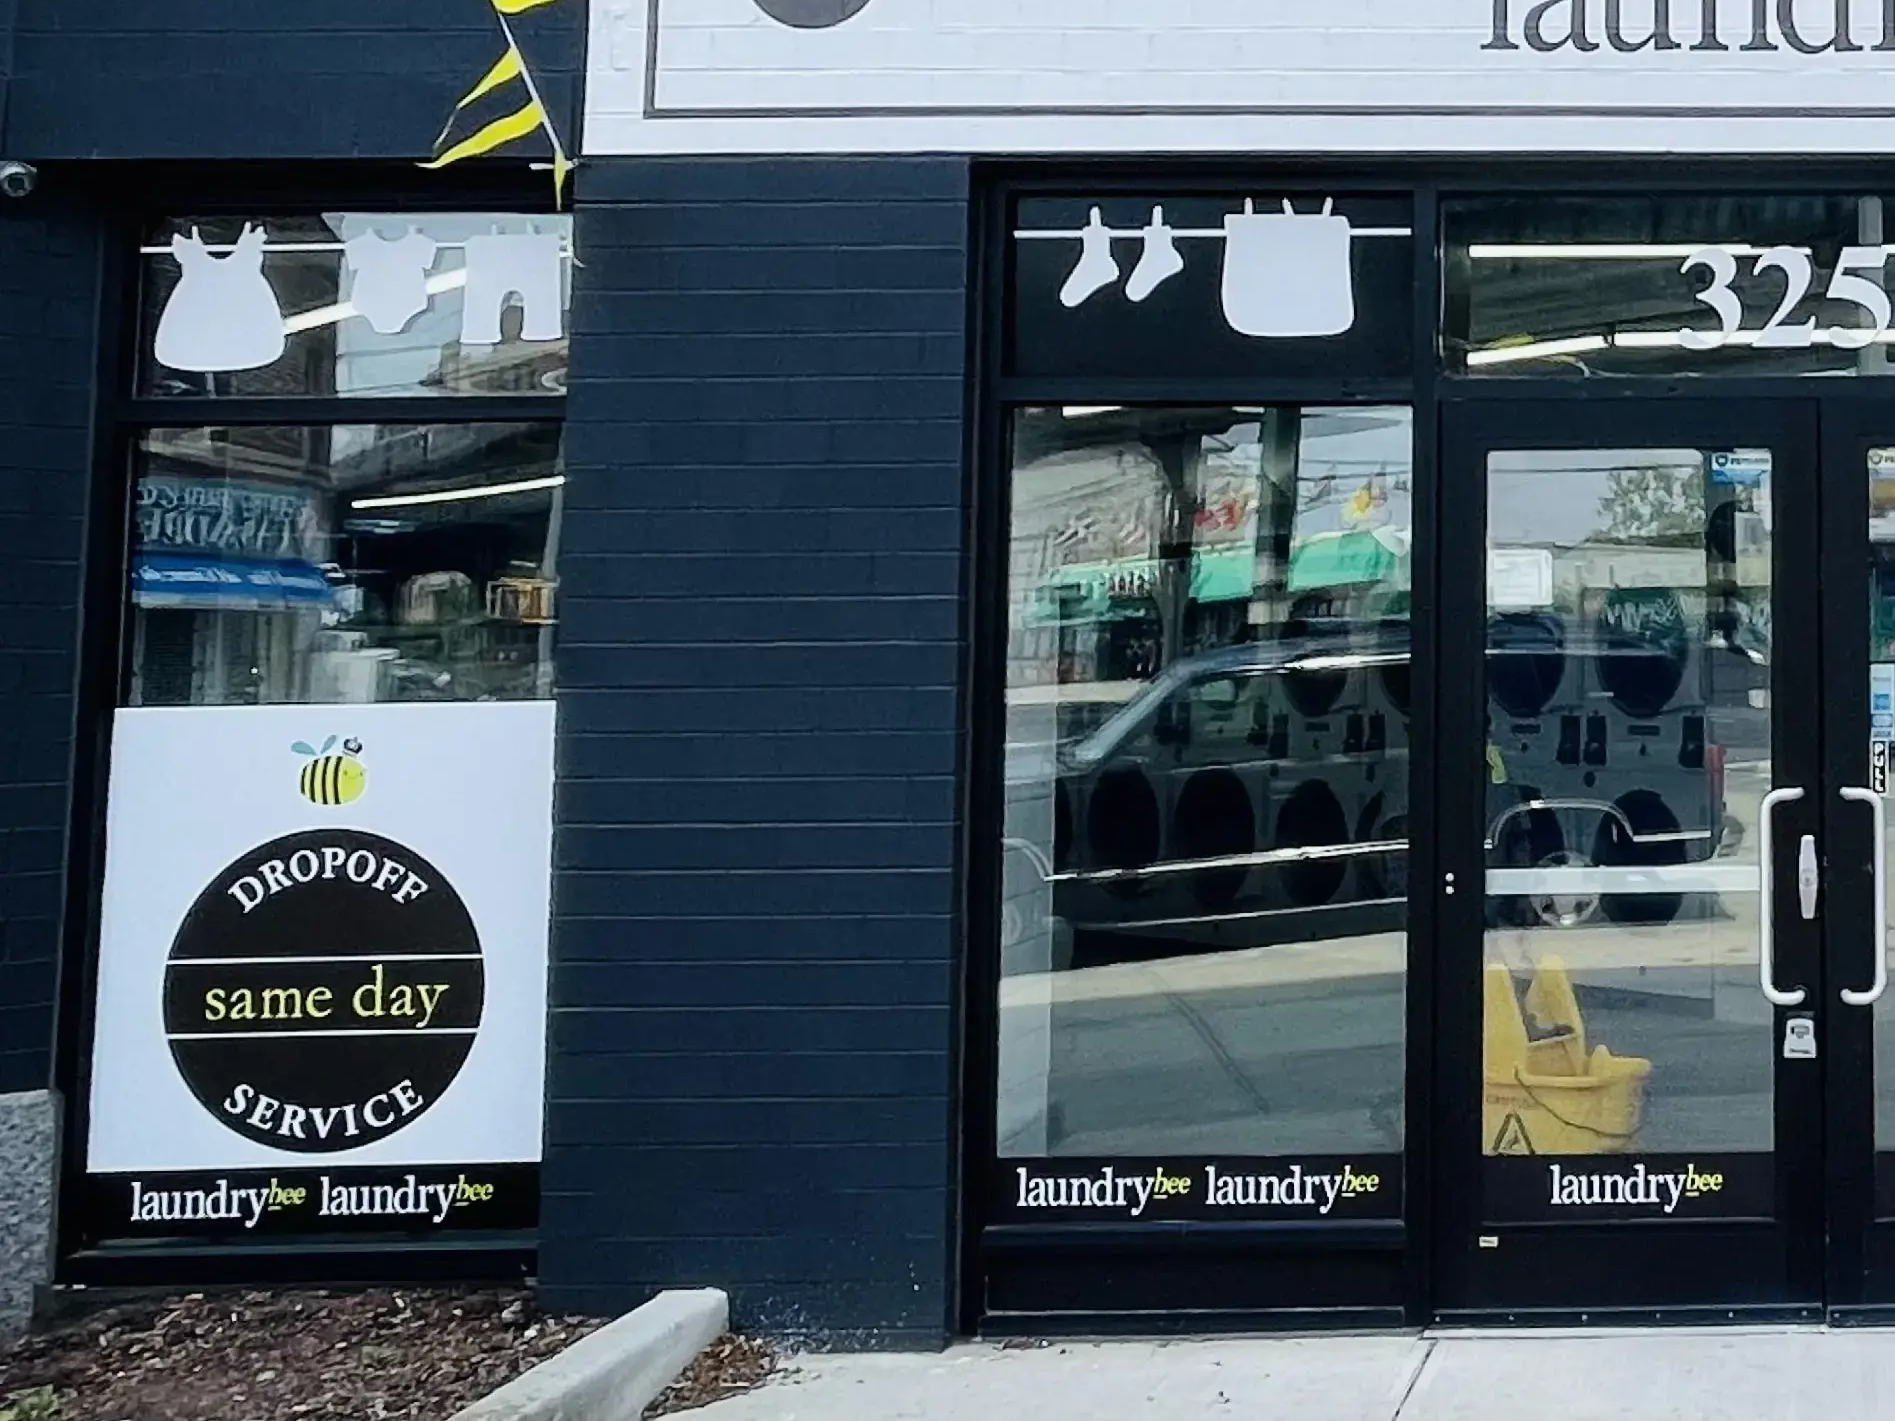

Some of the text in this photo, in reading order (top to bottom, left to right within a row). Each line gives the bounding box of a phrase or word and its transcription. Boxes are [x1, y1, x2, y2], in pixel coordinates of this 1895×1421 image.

[227, 846, 429, 914] DROPOFF
[205, 964, 450, 1029] same day
[223, 1078, 424, 1139] SERVICE
